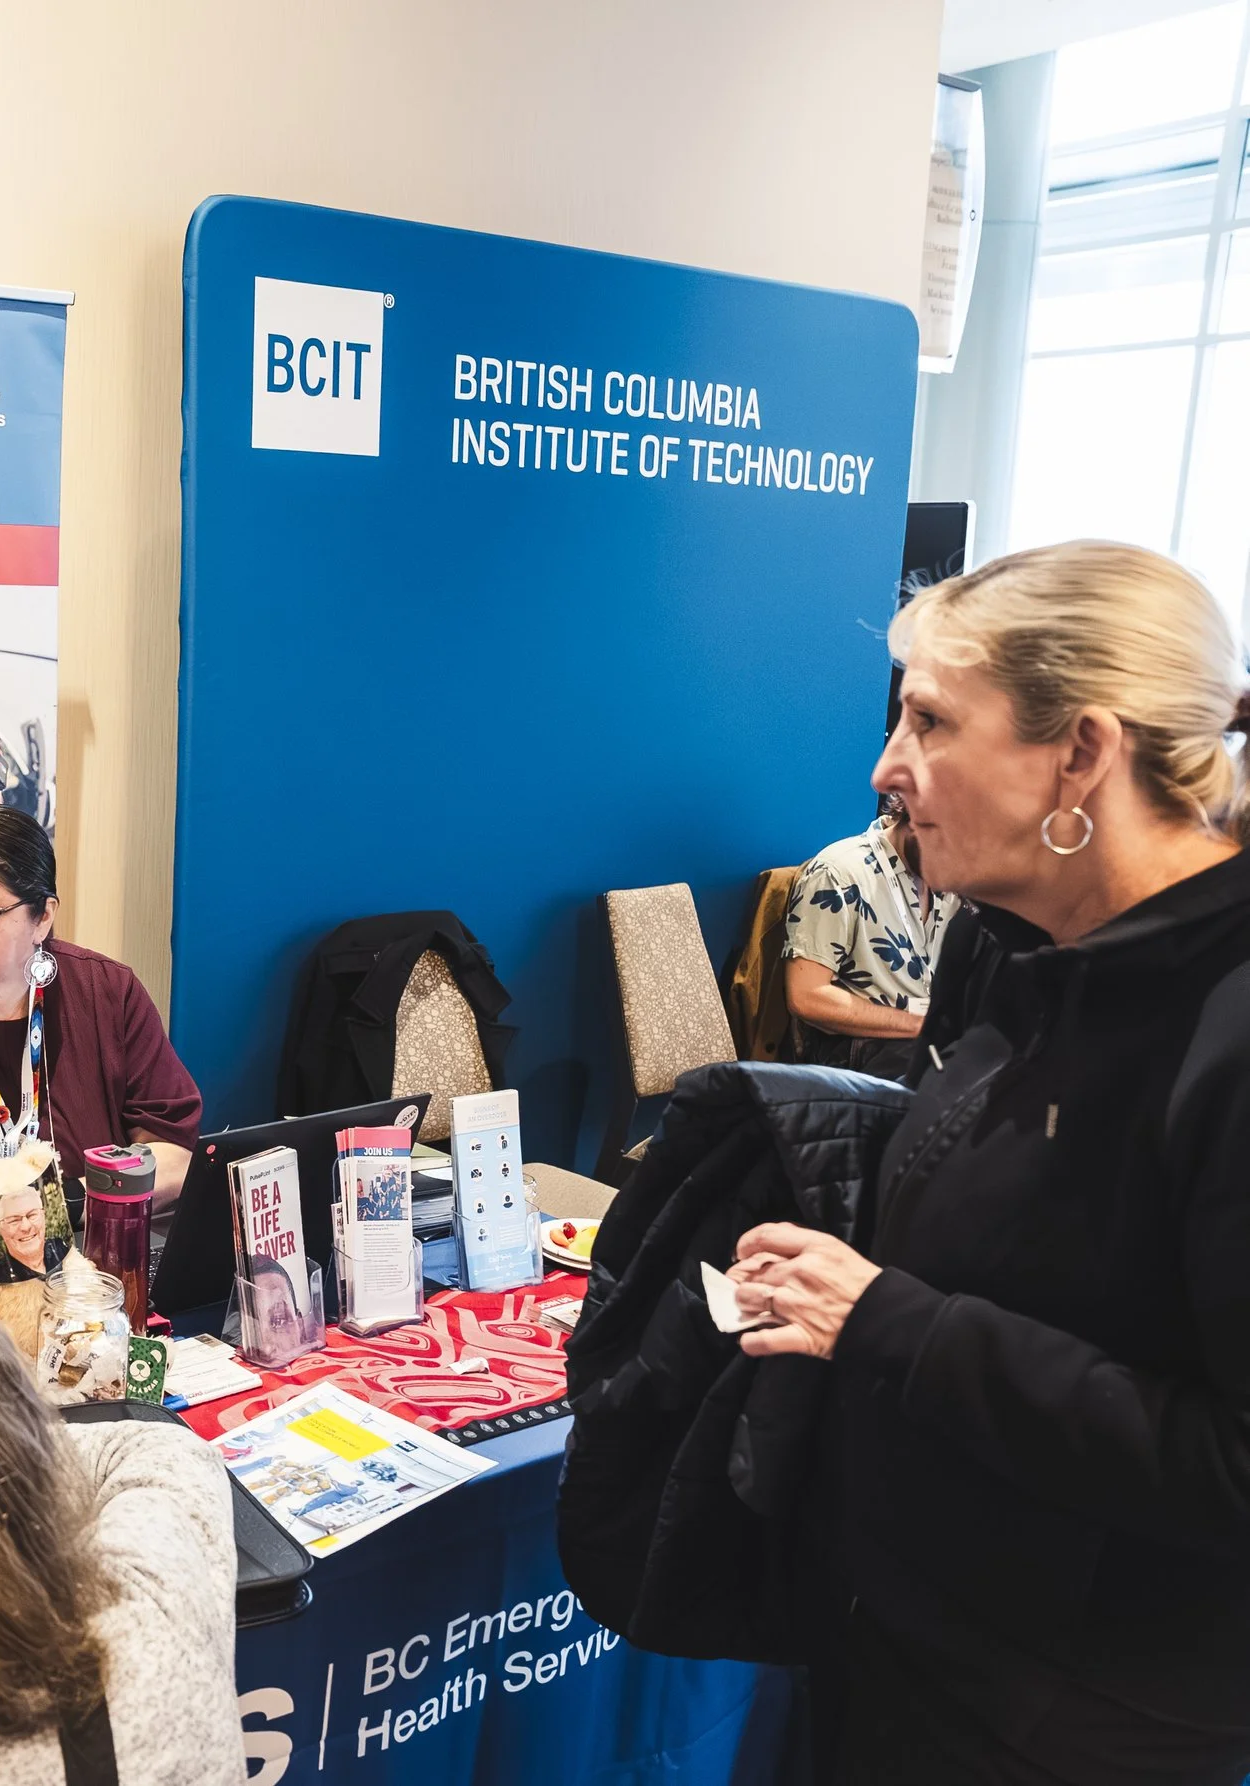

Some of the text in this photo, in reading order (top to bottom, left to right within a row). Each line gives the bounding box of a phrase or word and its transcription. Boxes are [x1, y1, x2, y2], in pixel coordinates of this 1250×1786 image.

[266, 332, 371, 401] BCIT
[455, 354, 761, 431] BRITISH COLUMBIA
[451, 417, 874, 496] INSTITUTE OF TECHNOLOGY
[363, 1147, 393, 1156] JOIN US
[251, 1180, 281, 1213] BE A
[253, 1208, 280, 1241] LIFE
[255, 1230, 296, 1260] SAVER
[362, 1588, 582, 1696] BC Emerg
[357, 1624, 621, 1758] Health Servic
